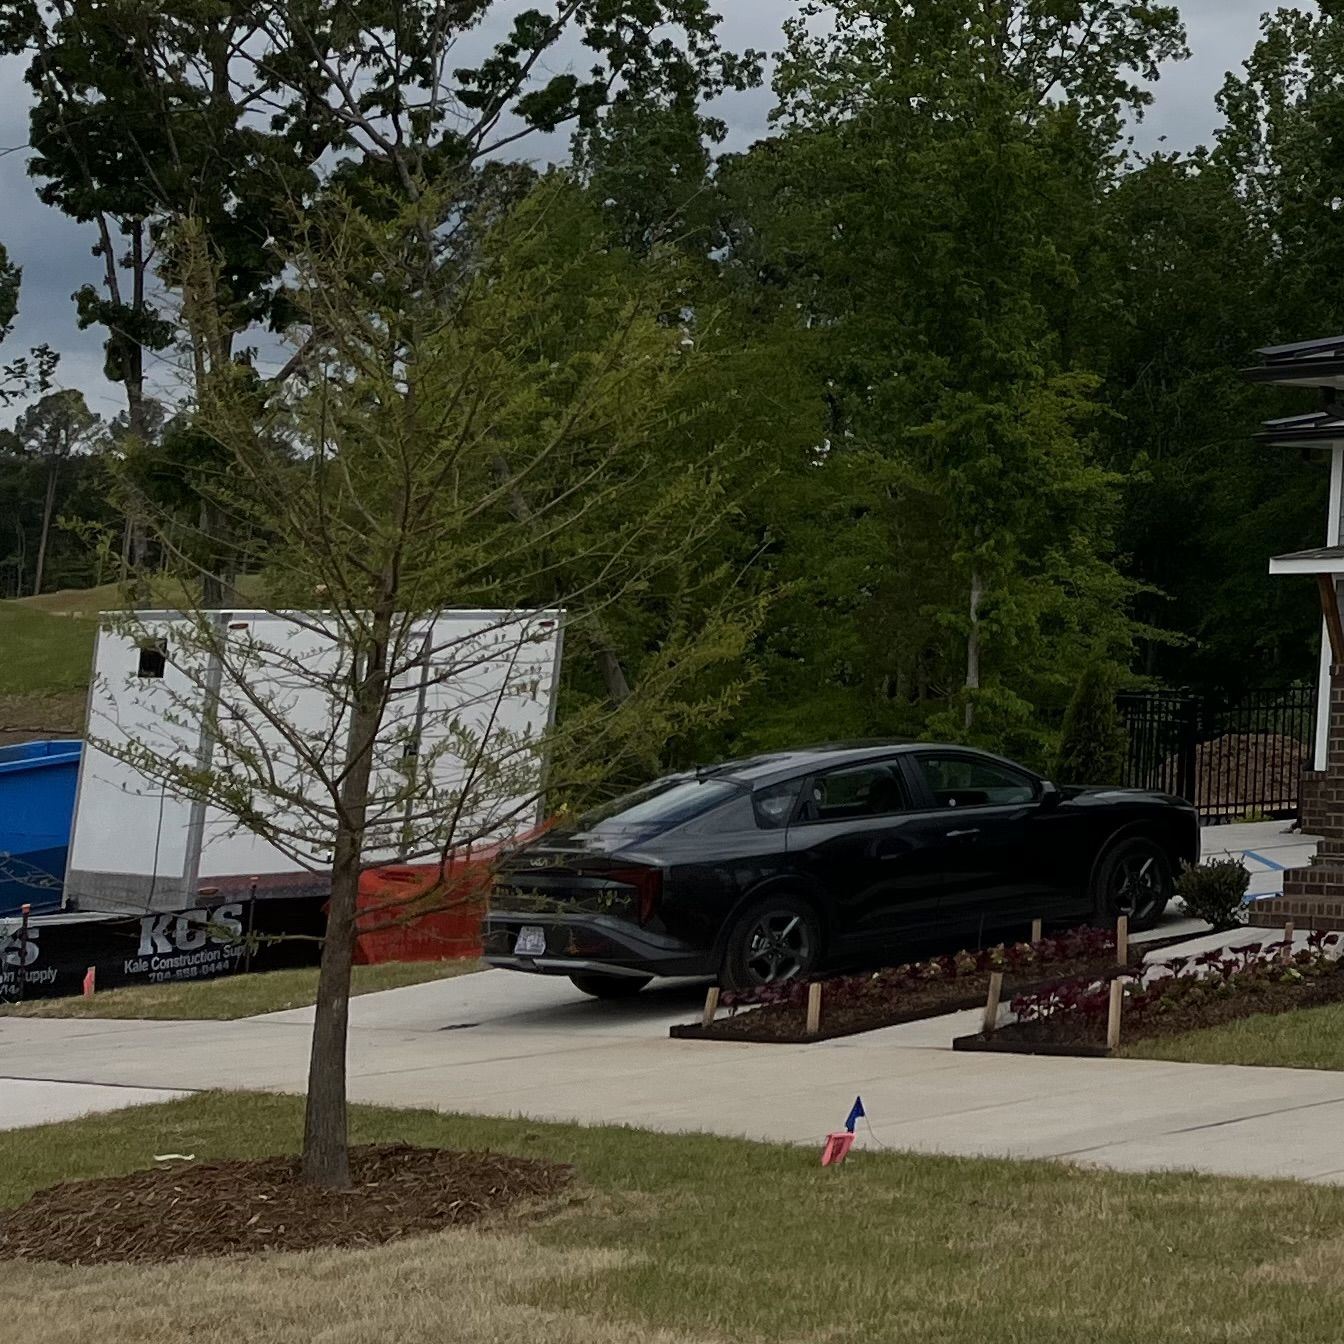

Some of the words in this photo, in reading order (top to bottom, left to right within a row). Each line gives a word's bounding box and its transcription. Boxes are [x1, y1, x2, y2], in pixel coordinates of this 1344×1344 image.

[137, 903, 243, 956] KCS
[124, 957, 149, 974] Kale
[151, 949, 221, 971] Construction
